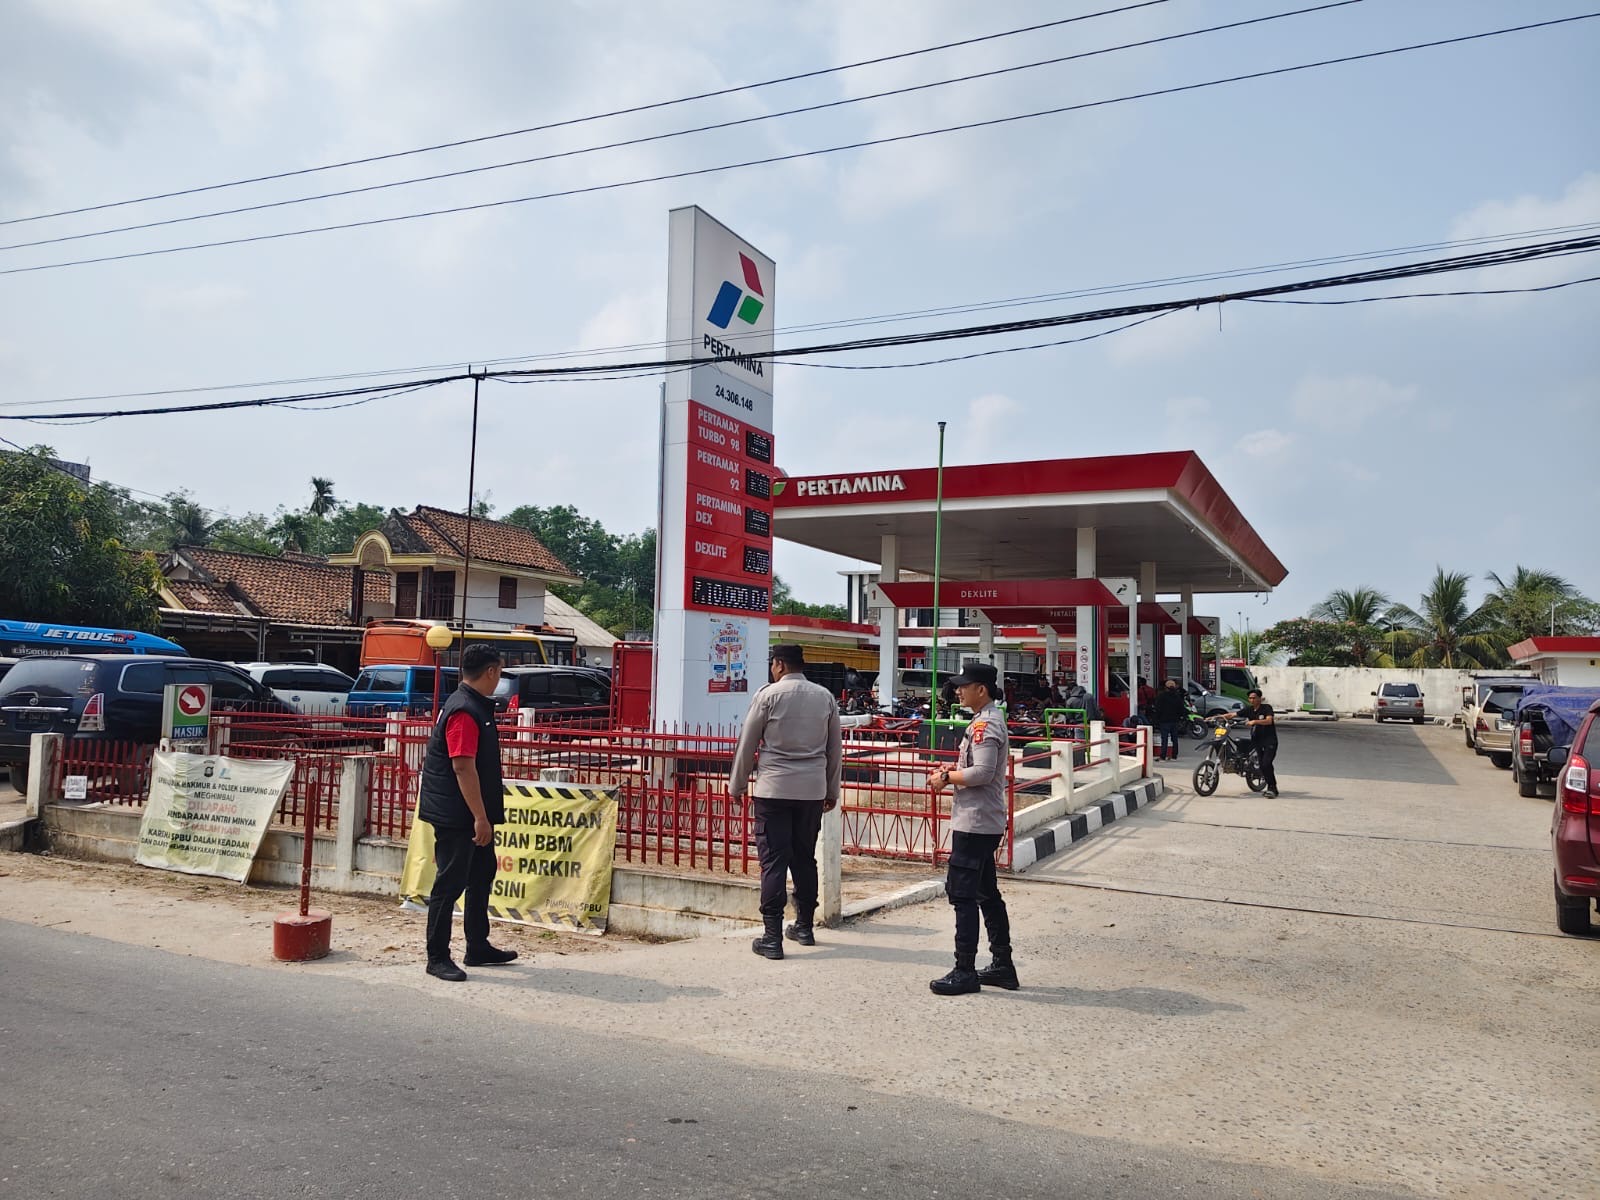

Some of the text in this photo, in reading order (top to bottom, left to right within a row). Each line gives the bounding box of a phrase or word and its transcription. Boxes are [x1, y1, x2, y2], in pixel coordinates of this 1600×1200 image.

[703, 333, 763, 377] PERTAMINA
[715, 384, 753, 411] 24.306.148
[698, 408, 740, 434] PERTAMAX
[698, 425, 725, 445] TURBO
[730, 438, 740, 452] 98
[697, 450, 739, 474] PERTAMAX
[730, 478, 740, 491] 92
[797, 475, 906, 497] PERTAMINA
[696, 492, 742, 516] PERTAMINA
[695, 510, 713, 525] DEX
[695, 541, 727, 558] DEXLITE
[871, 589, 876, 600] 1
[960, 590, 998, 598] DEXLITE
[972, 609, 977, 617] 3
[43, 628, 114, 642] JETBUS
[173, 726, 204, 738] MASUK
[211, 814, 231, 824] ANTRI
[231, 817, 257, 827] MINYAK
[170, 832, 191, 842] SPBU
[193, 834, 216, 845] DALAM
[217, 838, 250, 849] KEADAAN
[494, 830, 573, 853] SIAN BBM
[518, 857, 582, 879] PARKIR
[579, 902, 602, 912] SPBU
